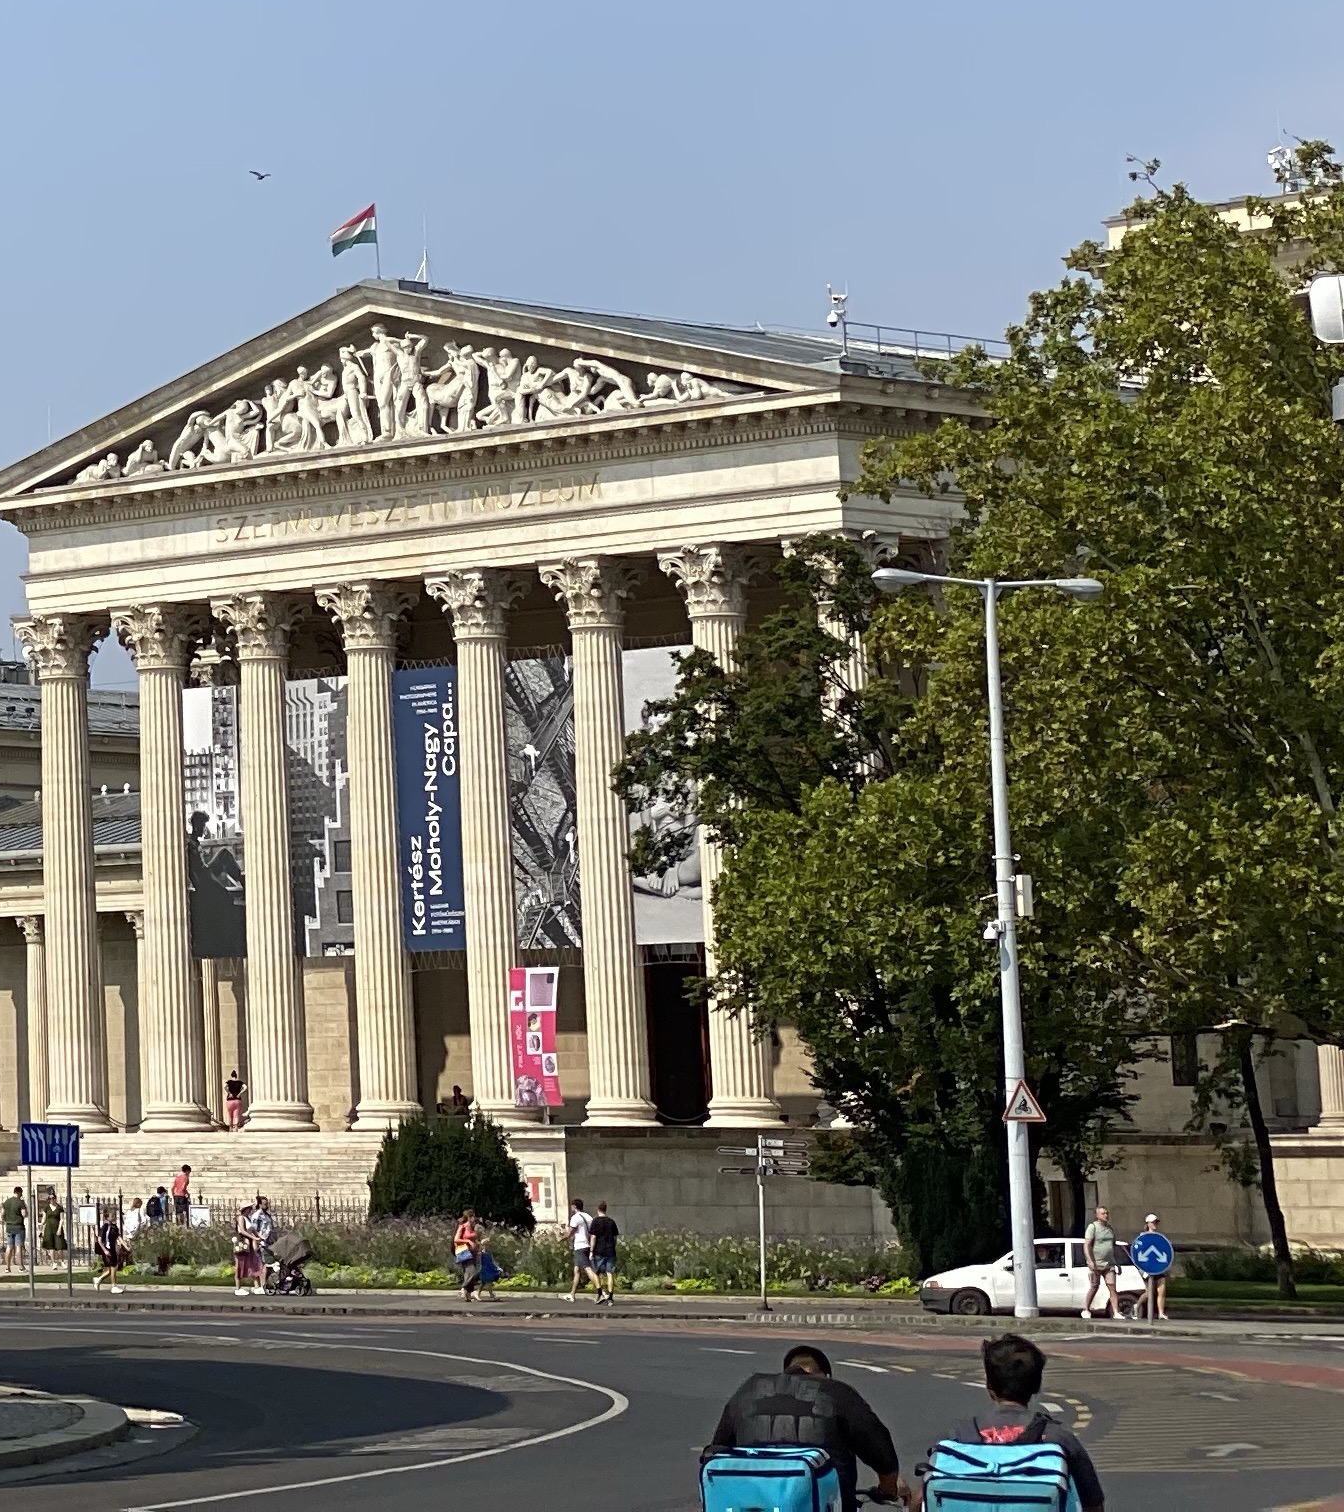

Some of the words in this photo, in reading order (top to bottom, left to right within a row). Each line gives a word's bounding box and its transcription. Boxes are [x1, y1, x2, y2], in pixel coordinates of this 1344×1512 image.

[442, 682, 457, 777] Capa...
[423, 722, 444, 896] Moholy-Nagy
[408, 835, 427, 936] Kertész
